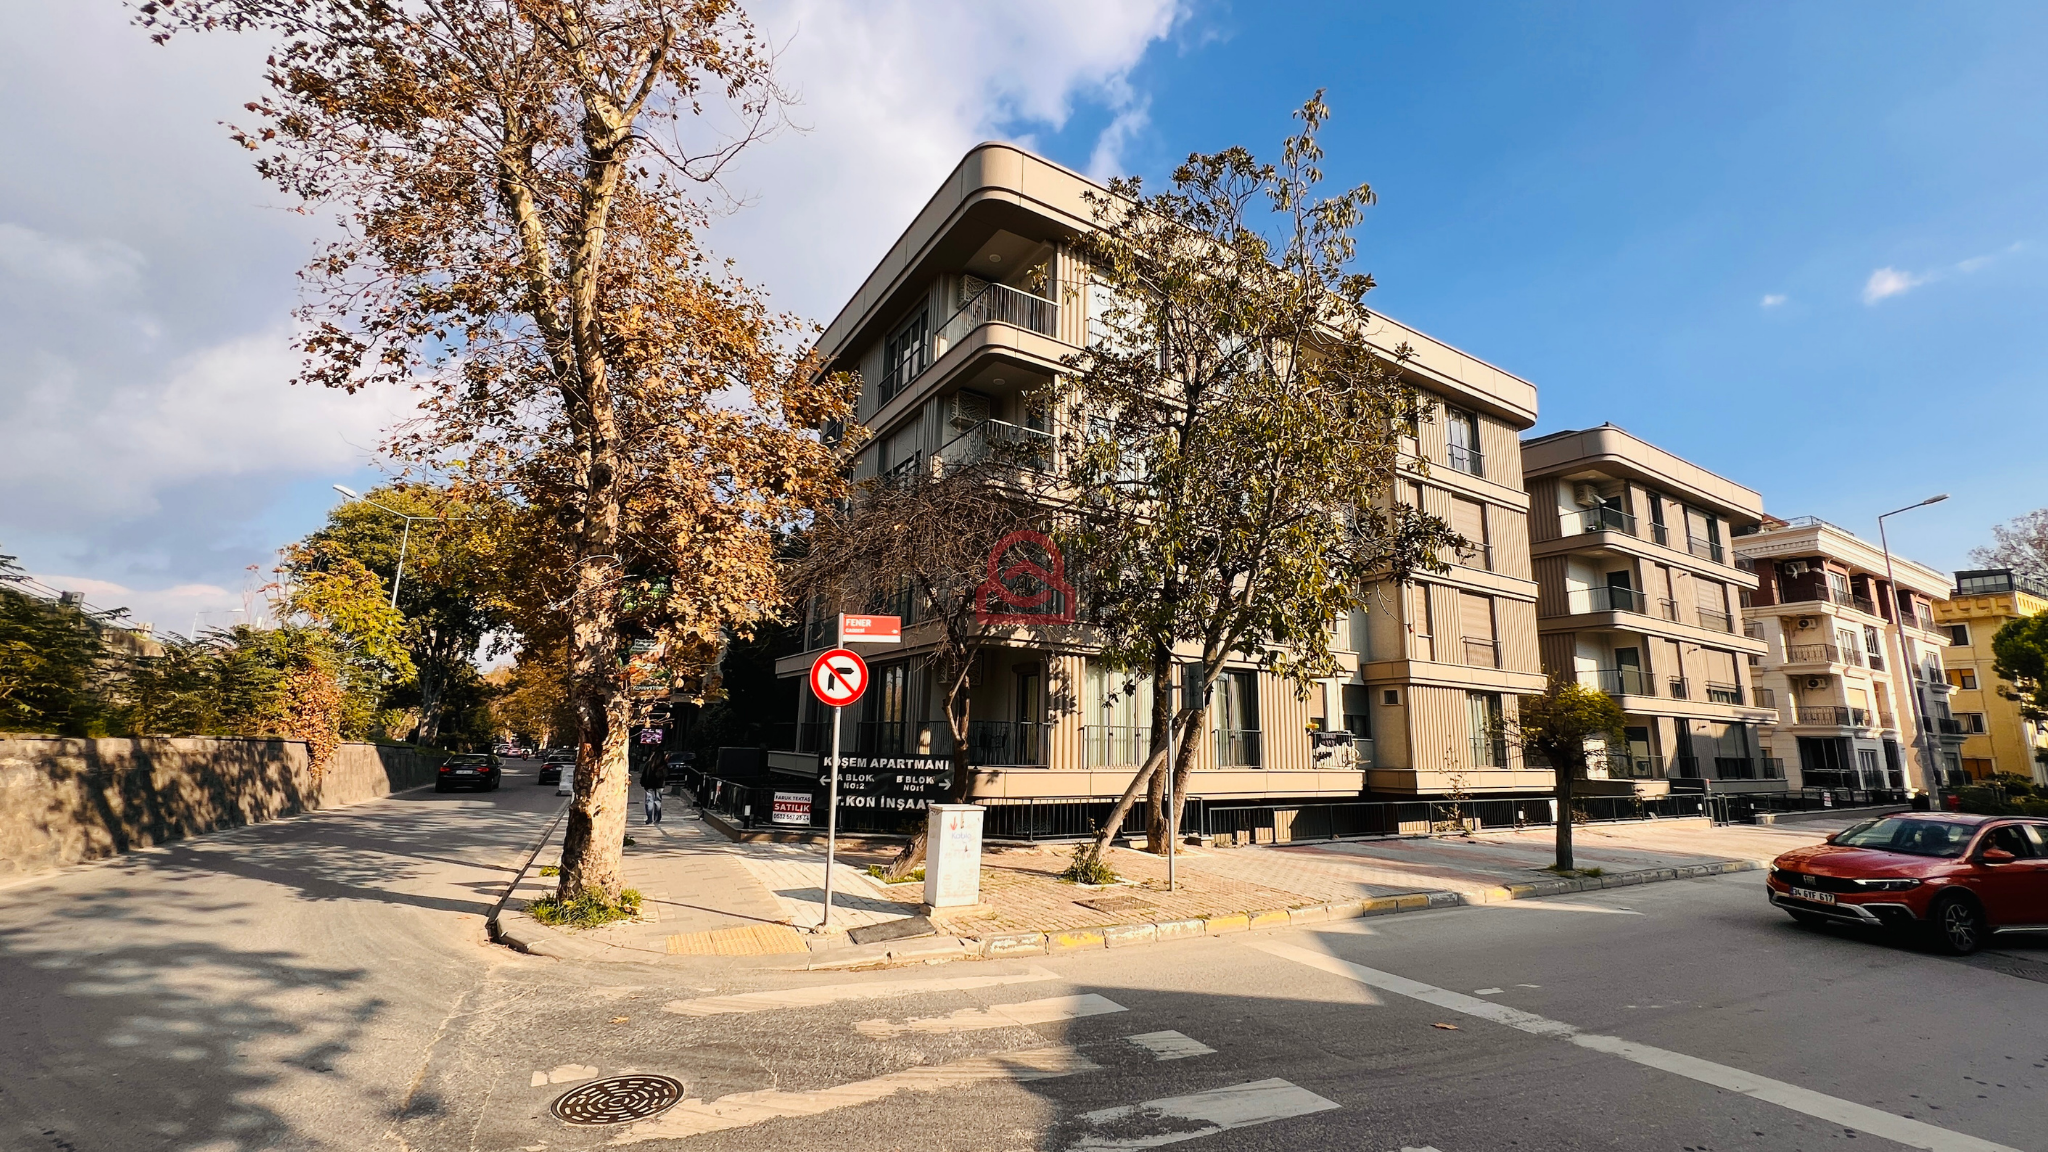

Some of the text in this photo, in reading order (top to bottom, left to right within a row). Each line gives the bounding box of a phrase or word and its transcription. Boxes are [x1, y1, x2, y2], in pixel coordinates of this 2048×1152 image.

[845, 618, 872, 627] FENER
[869, 757, 950, 770] APARTMANI
[846, 774, 875, 782] BLOK
[896, 775, 935, 784] B BLOK
[843, 782, 865, 790] NO:2
[903, 784, 924, 792] NO:1
[774, 803, 810, 812] SATILIK
[1793, 888, 1802, 896] 34
[1820, 893, 1833, 902] 617
